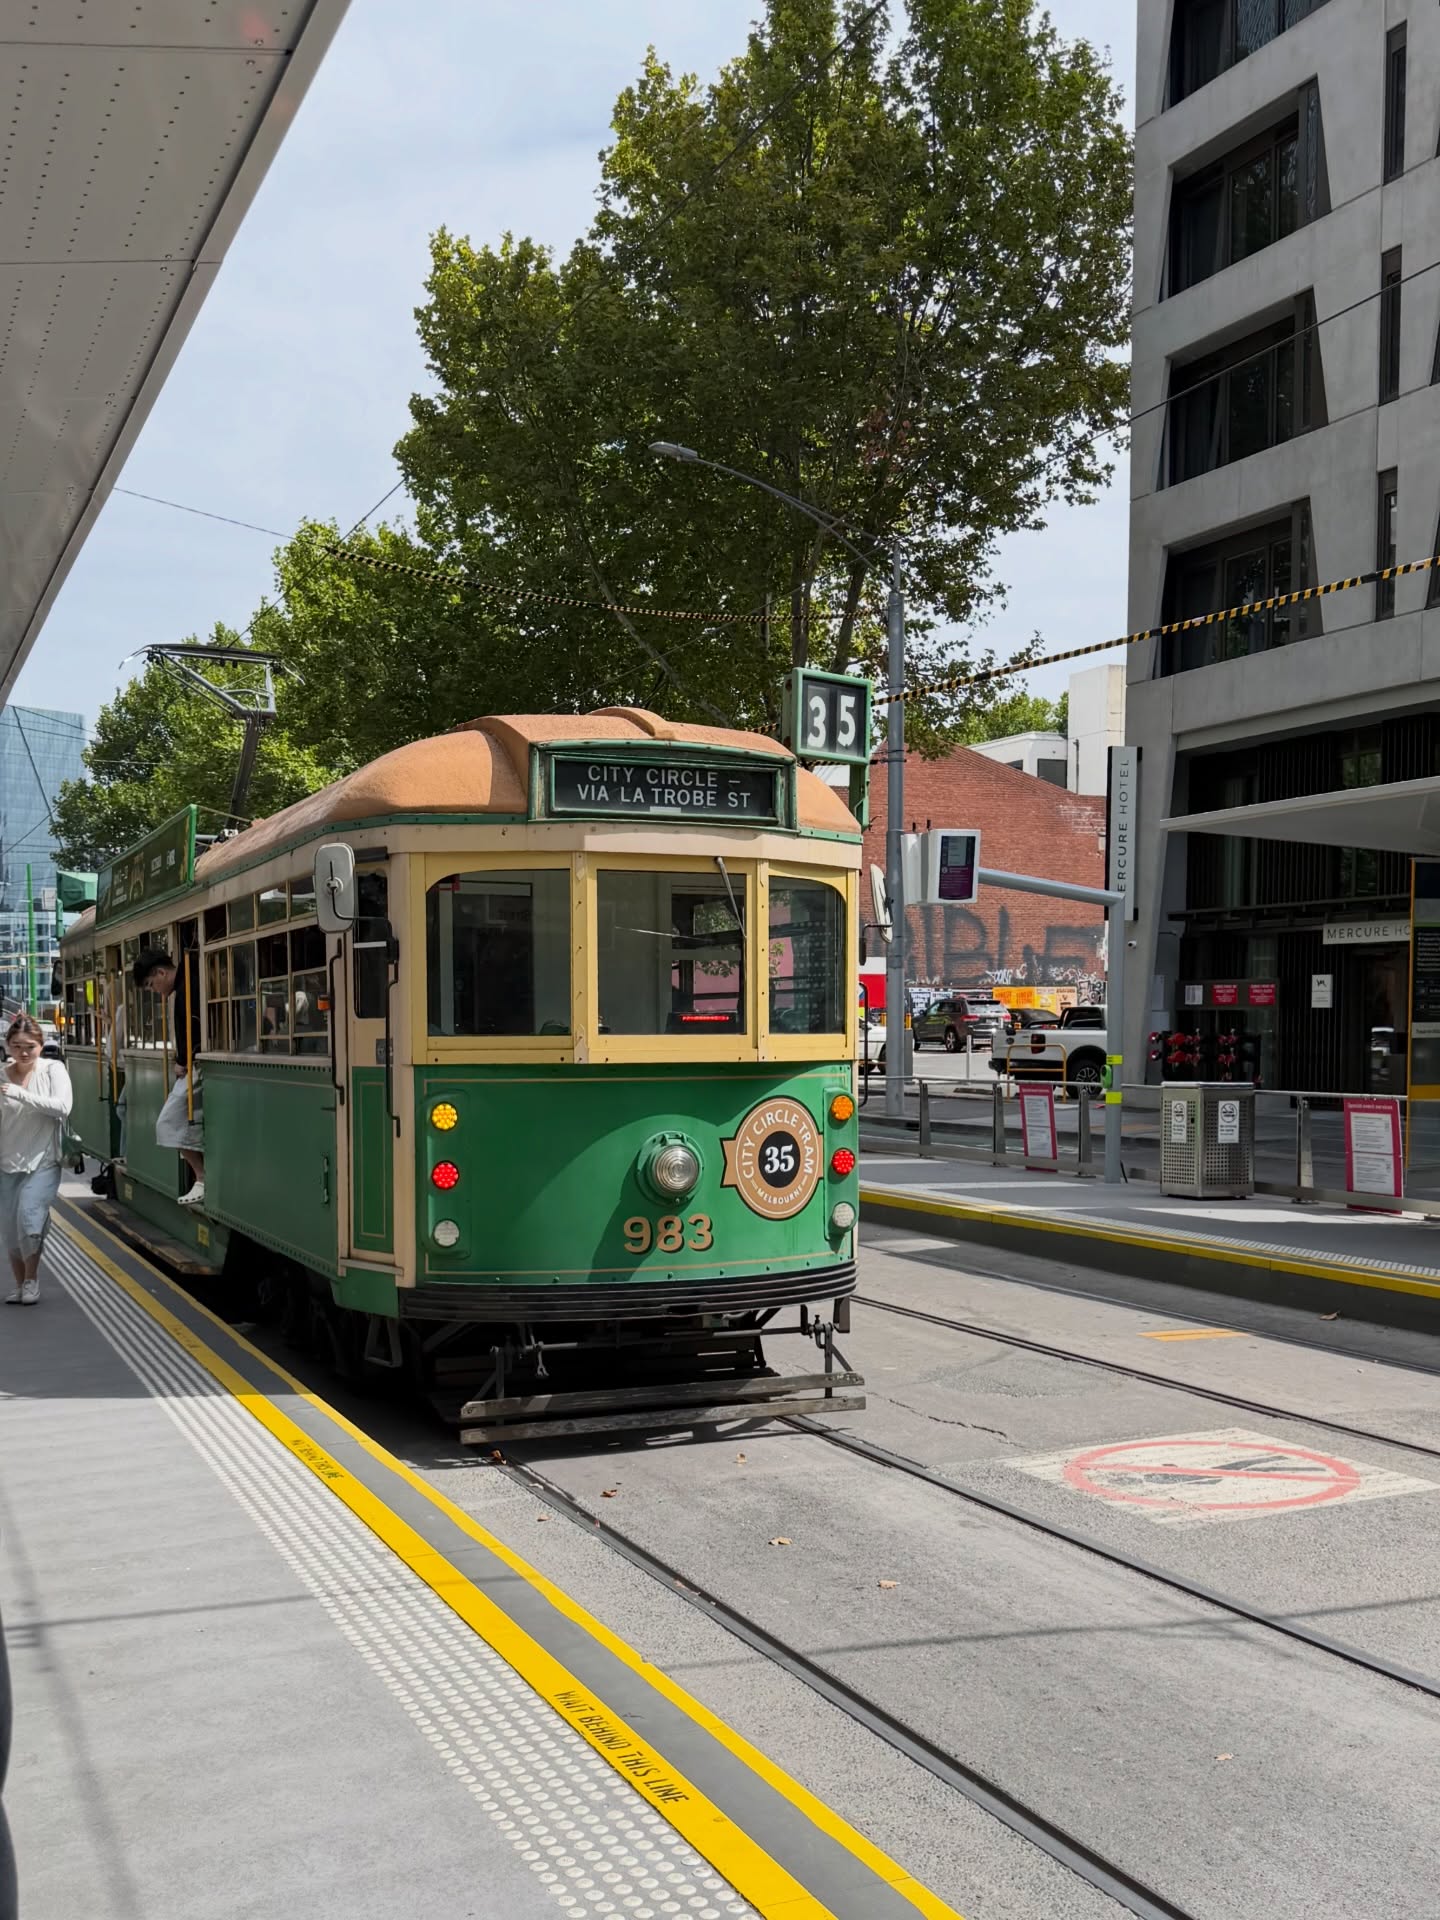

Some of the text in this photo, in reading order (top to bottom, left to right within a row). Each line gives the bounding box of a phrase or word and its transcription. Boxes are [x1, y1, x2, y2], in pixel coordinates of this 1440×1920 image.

[807, 695, 857, 748] 35
[587, 765, 635, 783] CITY
[646, 768, 719, 788] CIRCLE
[577, 783, 752, 809] VIA LA TROBE ST
[1117, 759, 1130, 892] ERCURE HOTEL
[1327, 926, 1389, 939] MERCURE
[742, 1109, 815, 1179] CITY CIRCLE TRAM
[764, 1144, 795, 1174] 35
[756, 1186, 803, 1204] MELBOURNE
[623, 1213, 714, 1254] 983
[553, 1690, 690, 1805] WAIT BEHIND THIS LINE
